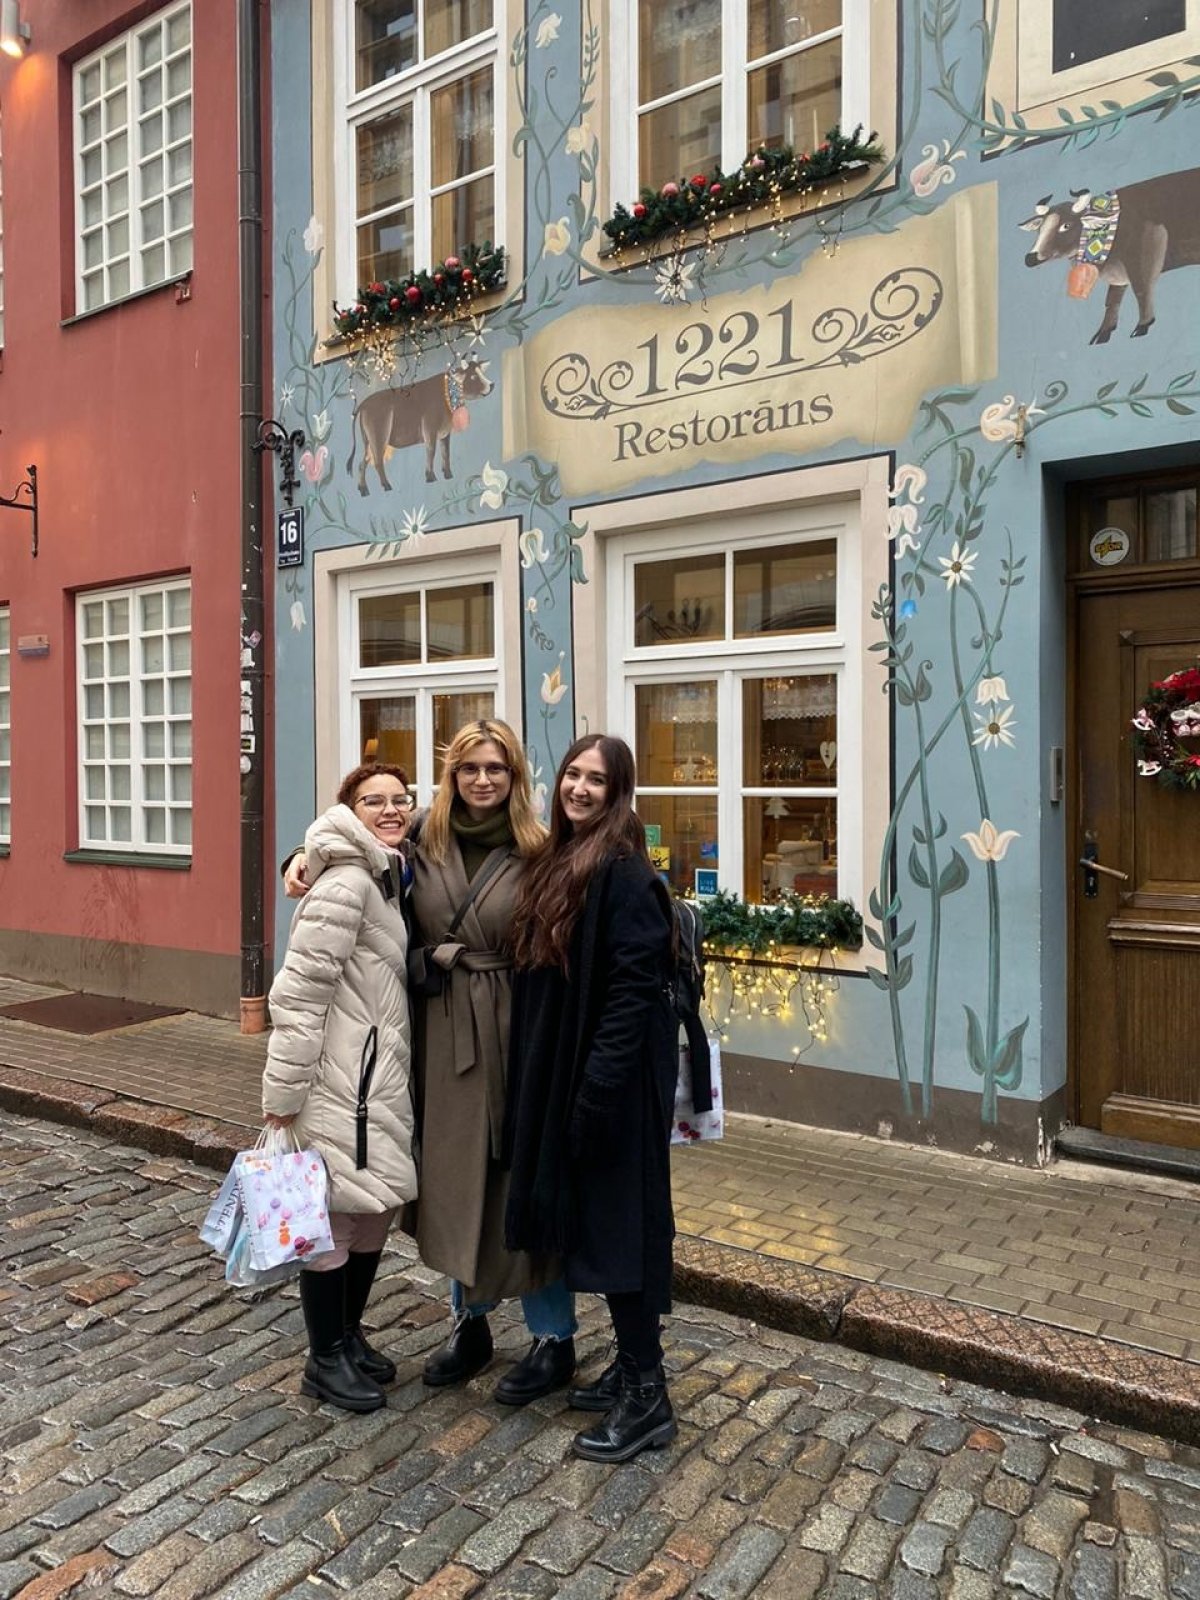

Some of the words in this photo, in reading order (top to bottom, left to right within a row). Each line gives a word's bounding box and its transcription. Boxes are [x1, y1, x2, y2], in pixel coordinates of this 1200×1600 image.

[636, 299, 805, 398] 1221
[612, 393, 834, 462] Restorāns
[280, 520, 298, 545] 16
